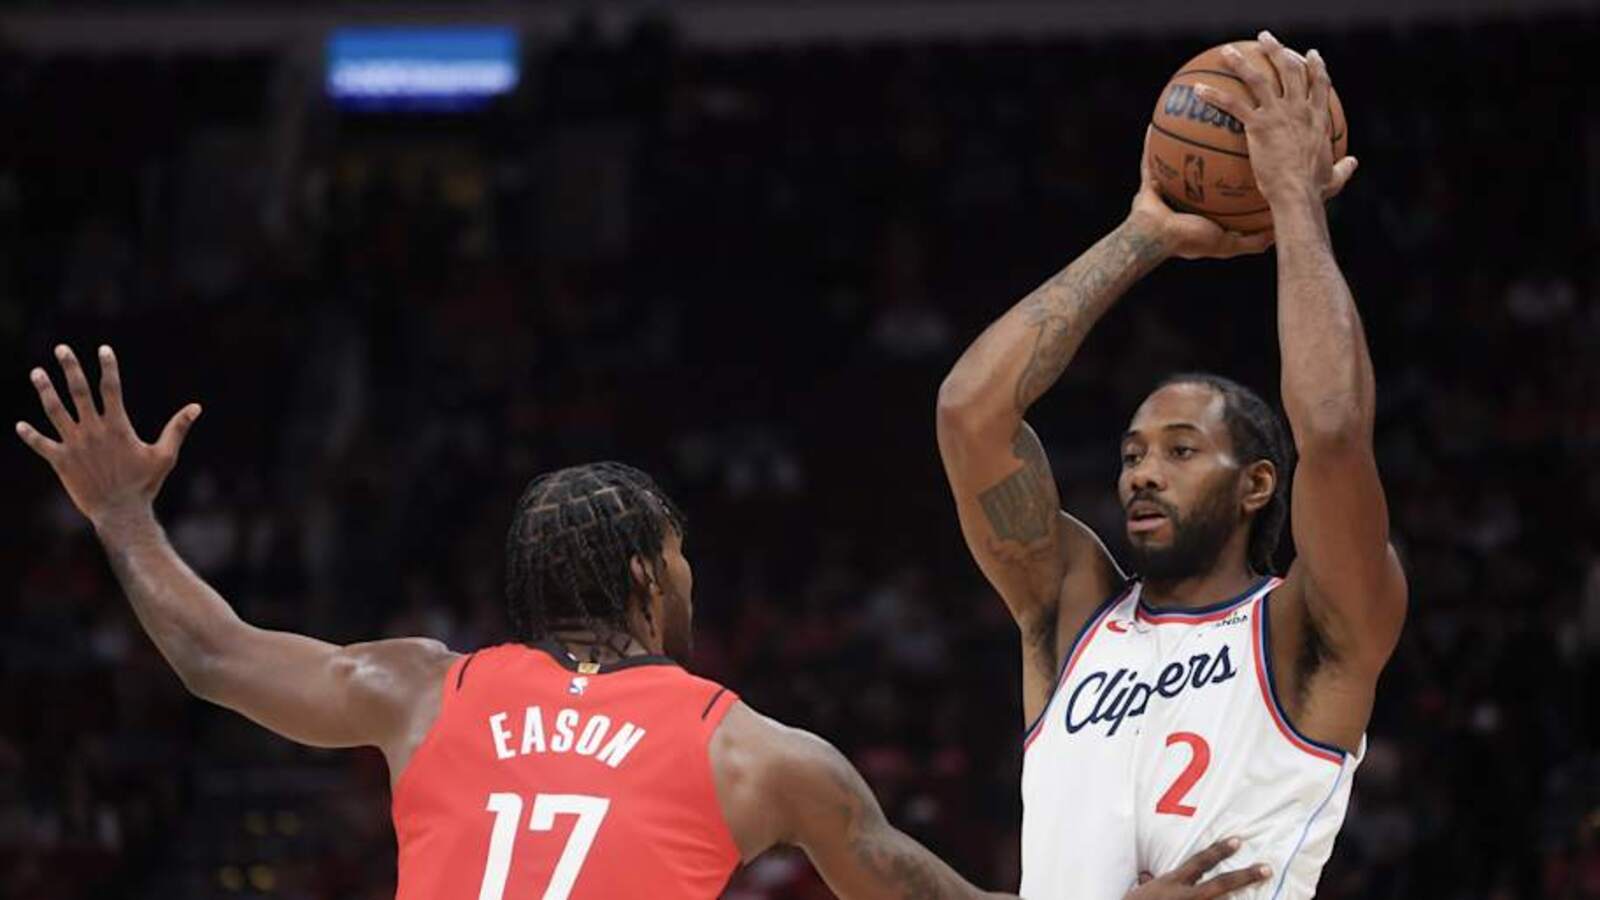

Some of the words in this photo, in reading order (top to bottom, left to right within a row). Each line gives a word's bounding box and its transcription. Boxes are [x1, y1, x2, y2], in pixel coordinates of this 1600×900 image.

[1065, 643, 1238, 737] Clipers
[489, 706, 646, 768] EASON
[1155, 731, 1212, 818] 2
[479, 792, 611, 900] 17
